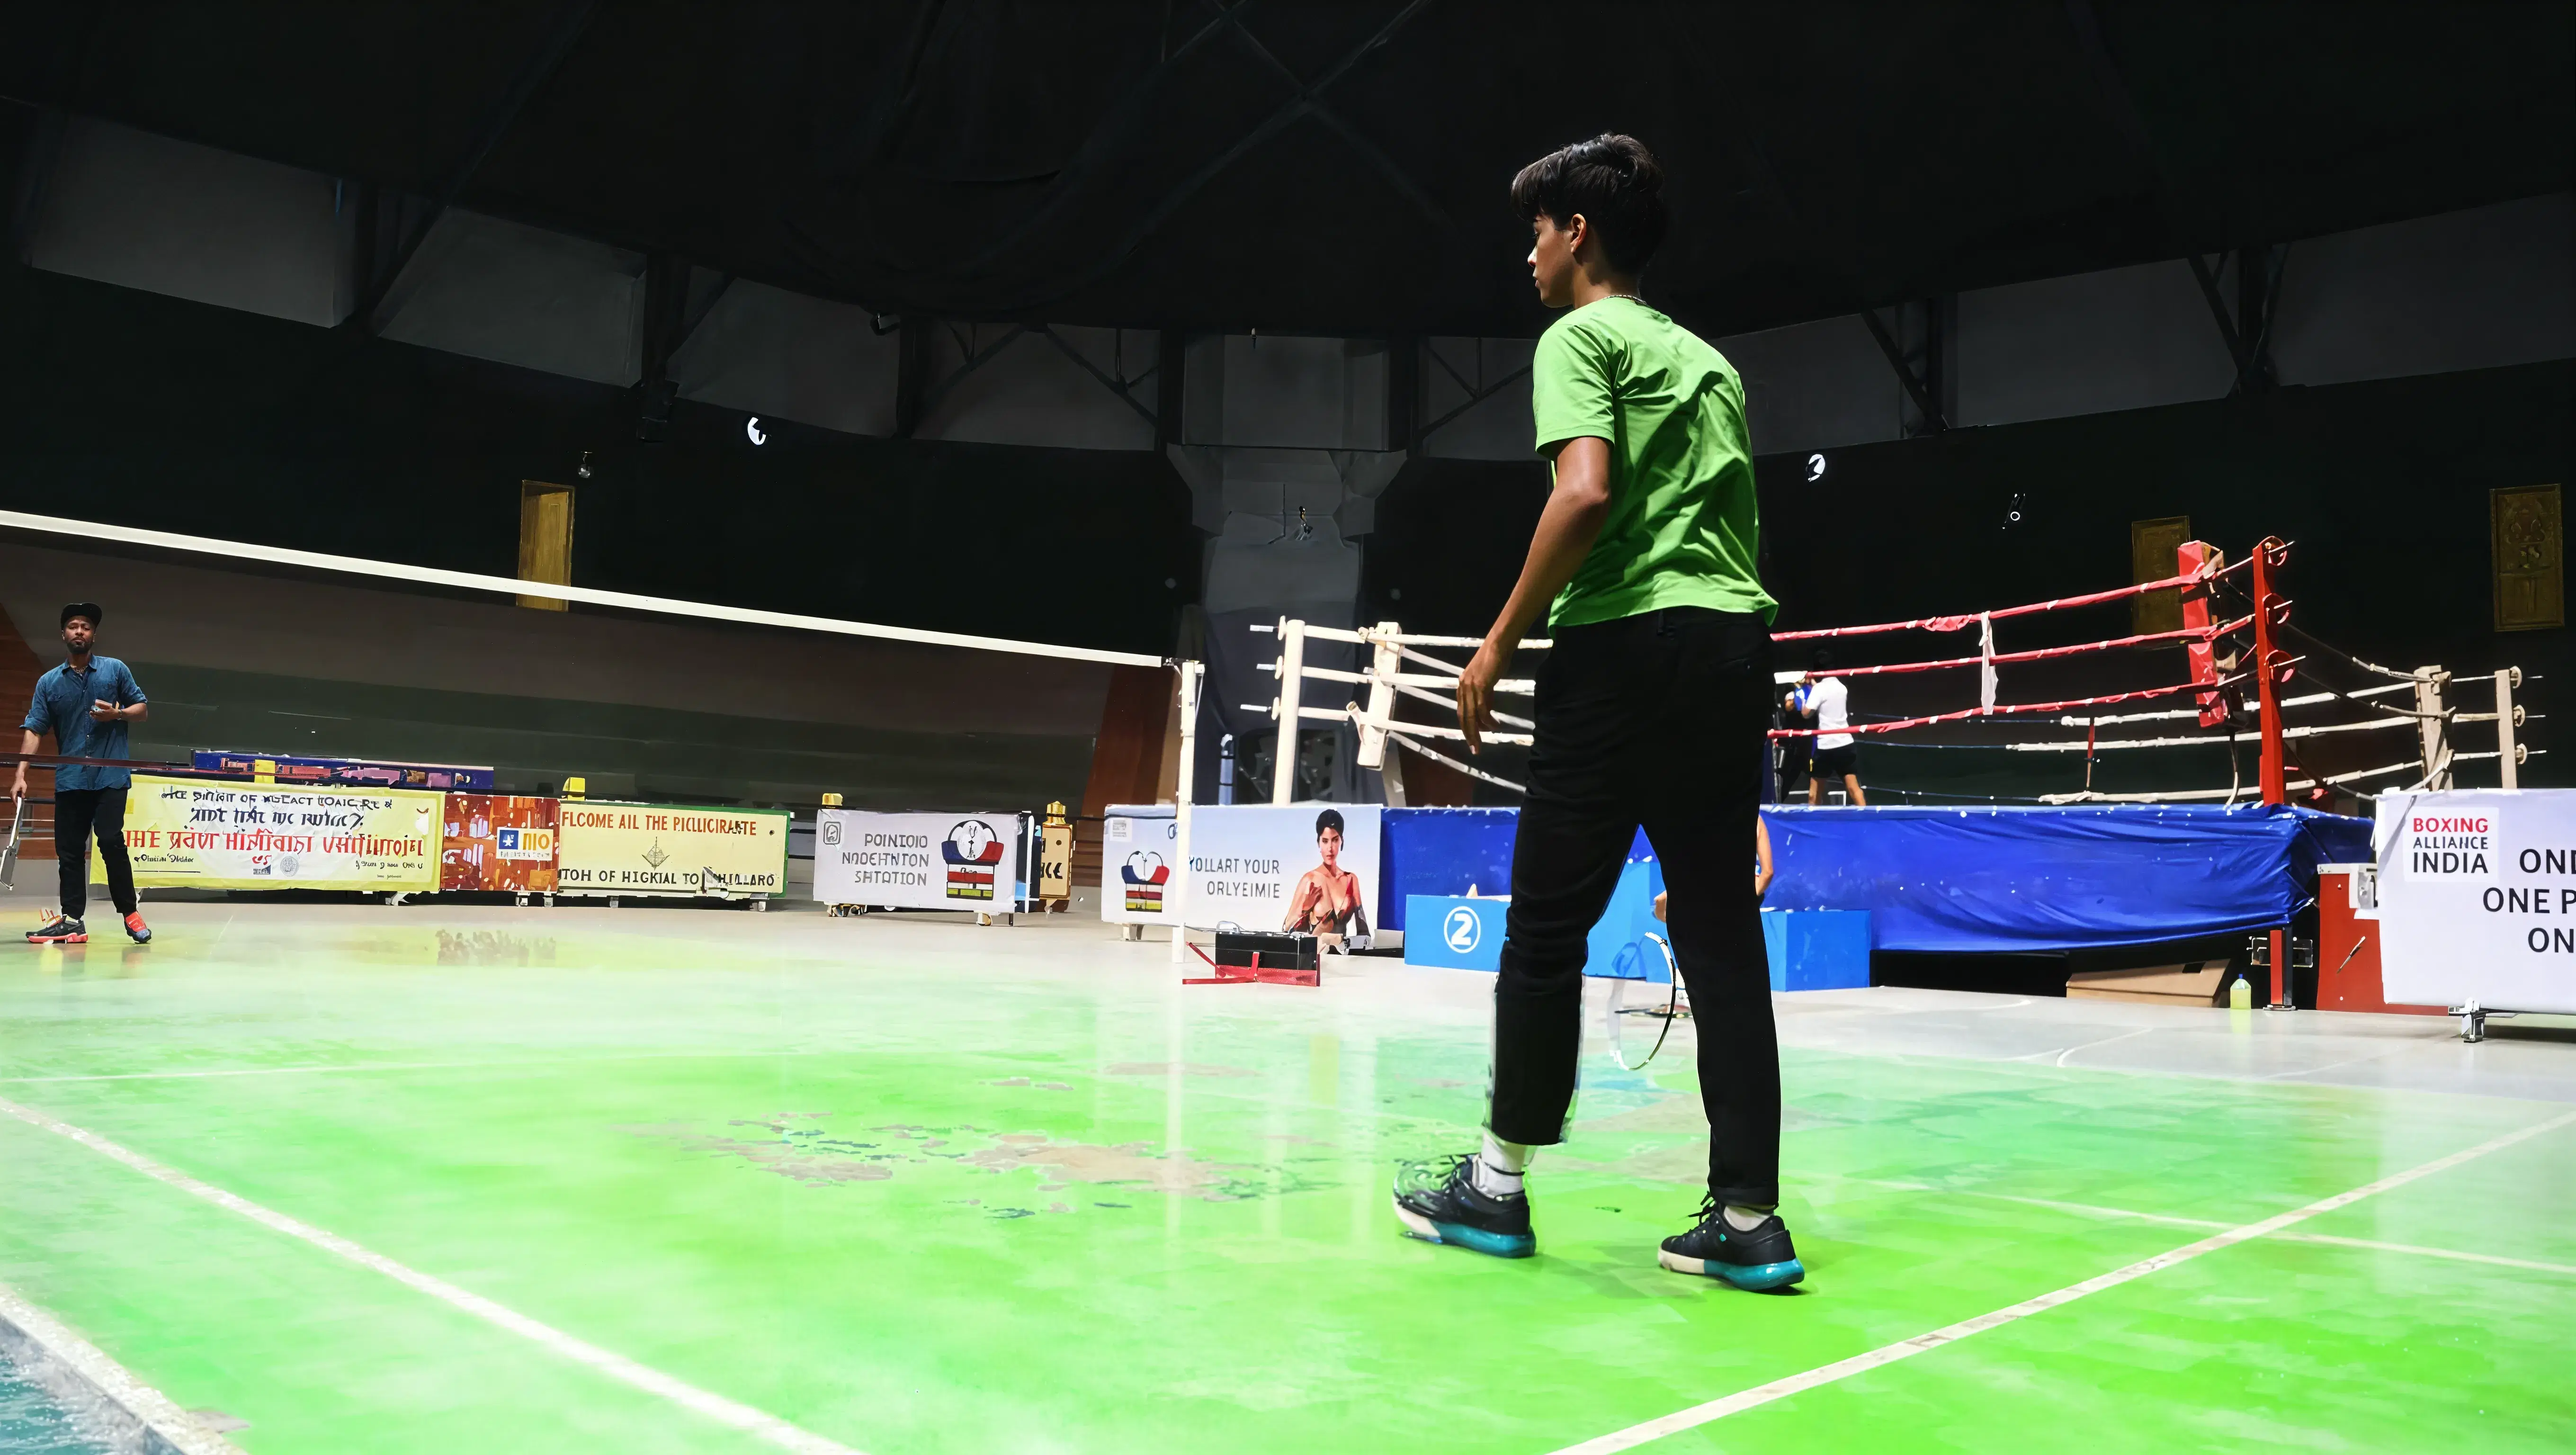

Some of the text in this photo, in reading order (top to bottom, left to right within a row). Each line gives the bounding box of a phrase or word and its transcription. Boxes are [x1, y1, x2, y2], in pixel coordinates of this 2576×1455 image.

[645, 815, 668, 830] THE
[2413, 818, 2488, 833] BOXING
[1244, 859, 1280, 874] YOUR
[2413, 852, 2488, 873] INDIA
[599, 870, 616, 882] OF
[682, 873, 699, 885] TO
[1207, 880, 1280, 898] ORLYEIMIE
[2483, 887, 2550, 913] ONE
[1451, 913, 1473, 945] 2
